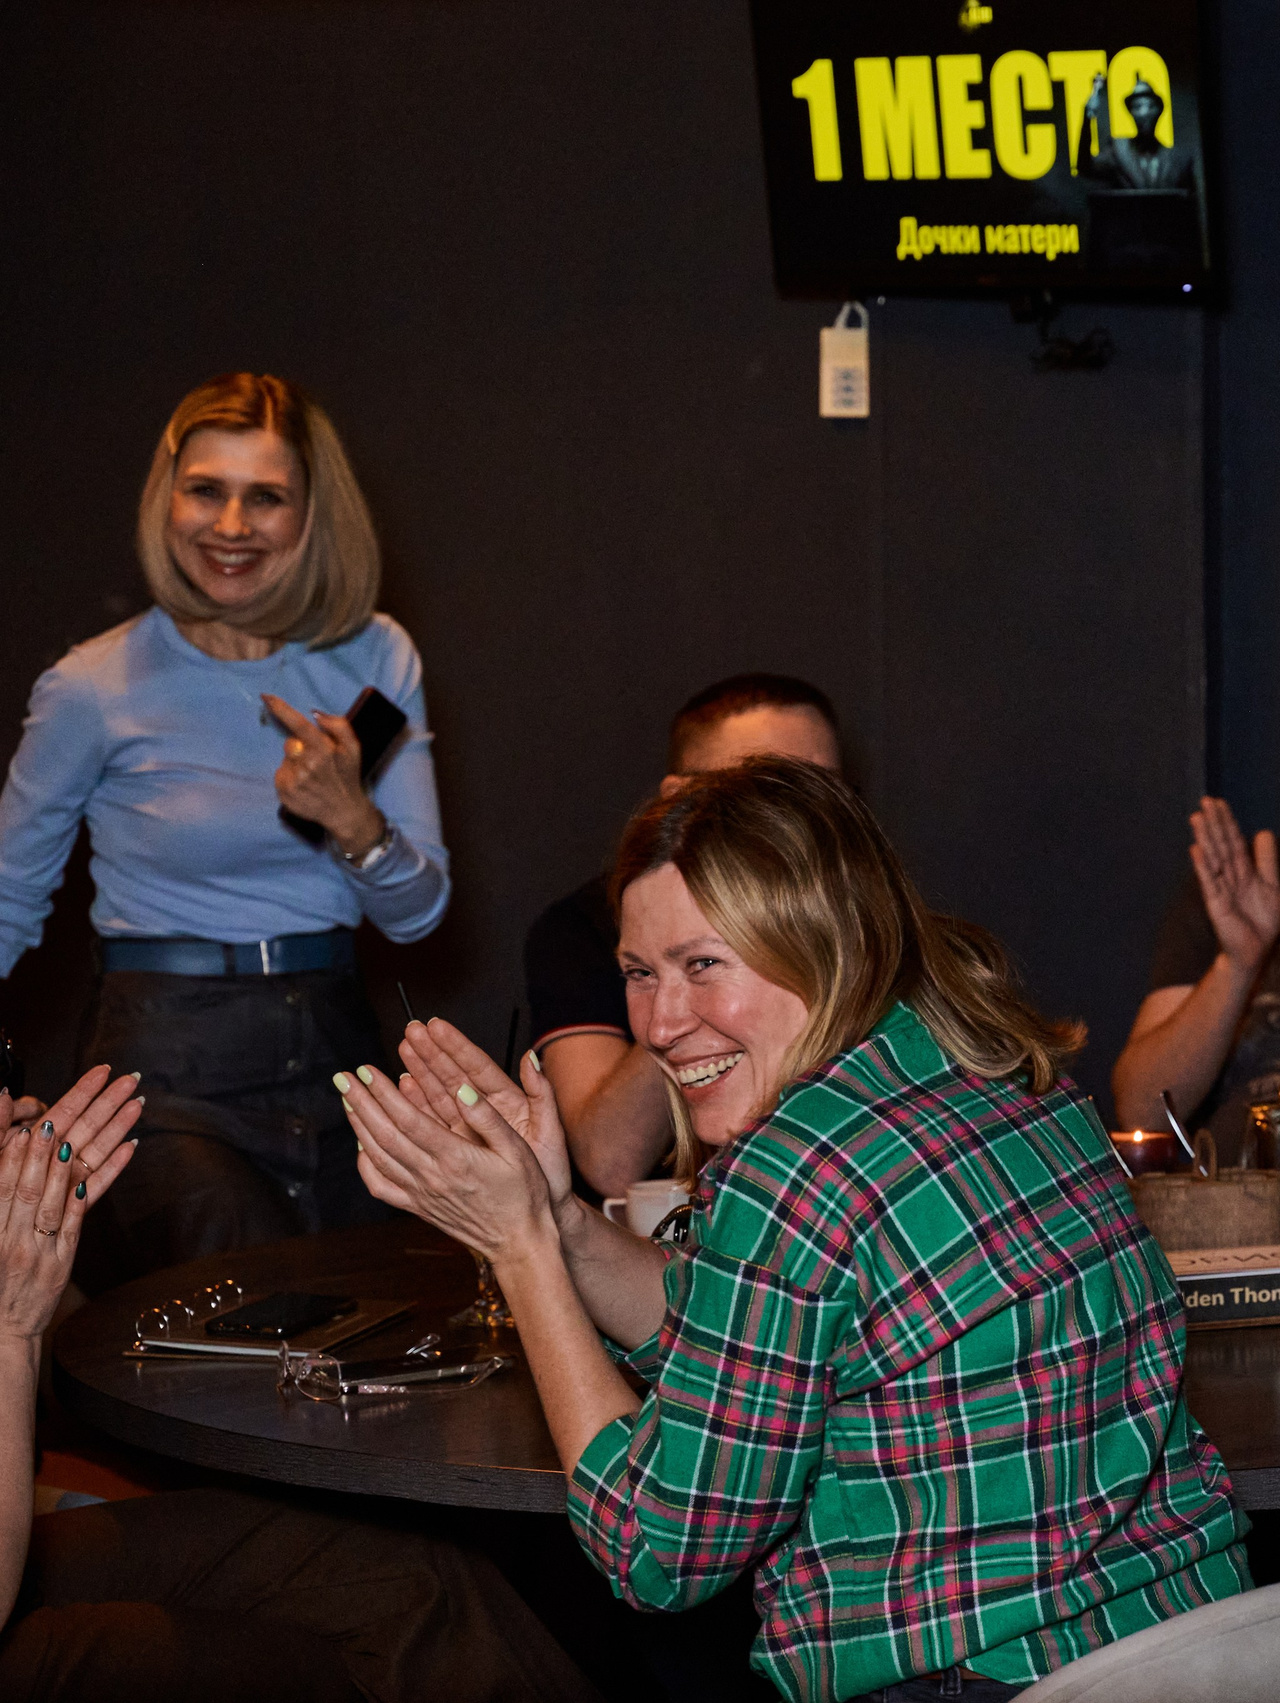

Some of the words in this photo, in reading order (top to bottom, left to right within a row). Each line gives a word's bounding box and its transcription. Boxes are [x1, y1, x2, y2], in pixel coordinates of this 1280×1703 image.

[792, 58, 843, 181] 1
[854, 45, 1174, 181] МЕСТО
[896, 216, 981, 261] Дочки
[984, 224, 1080, 261] матери
